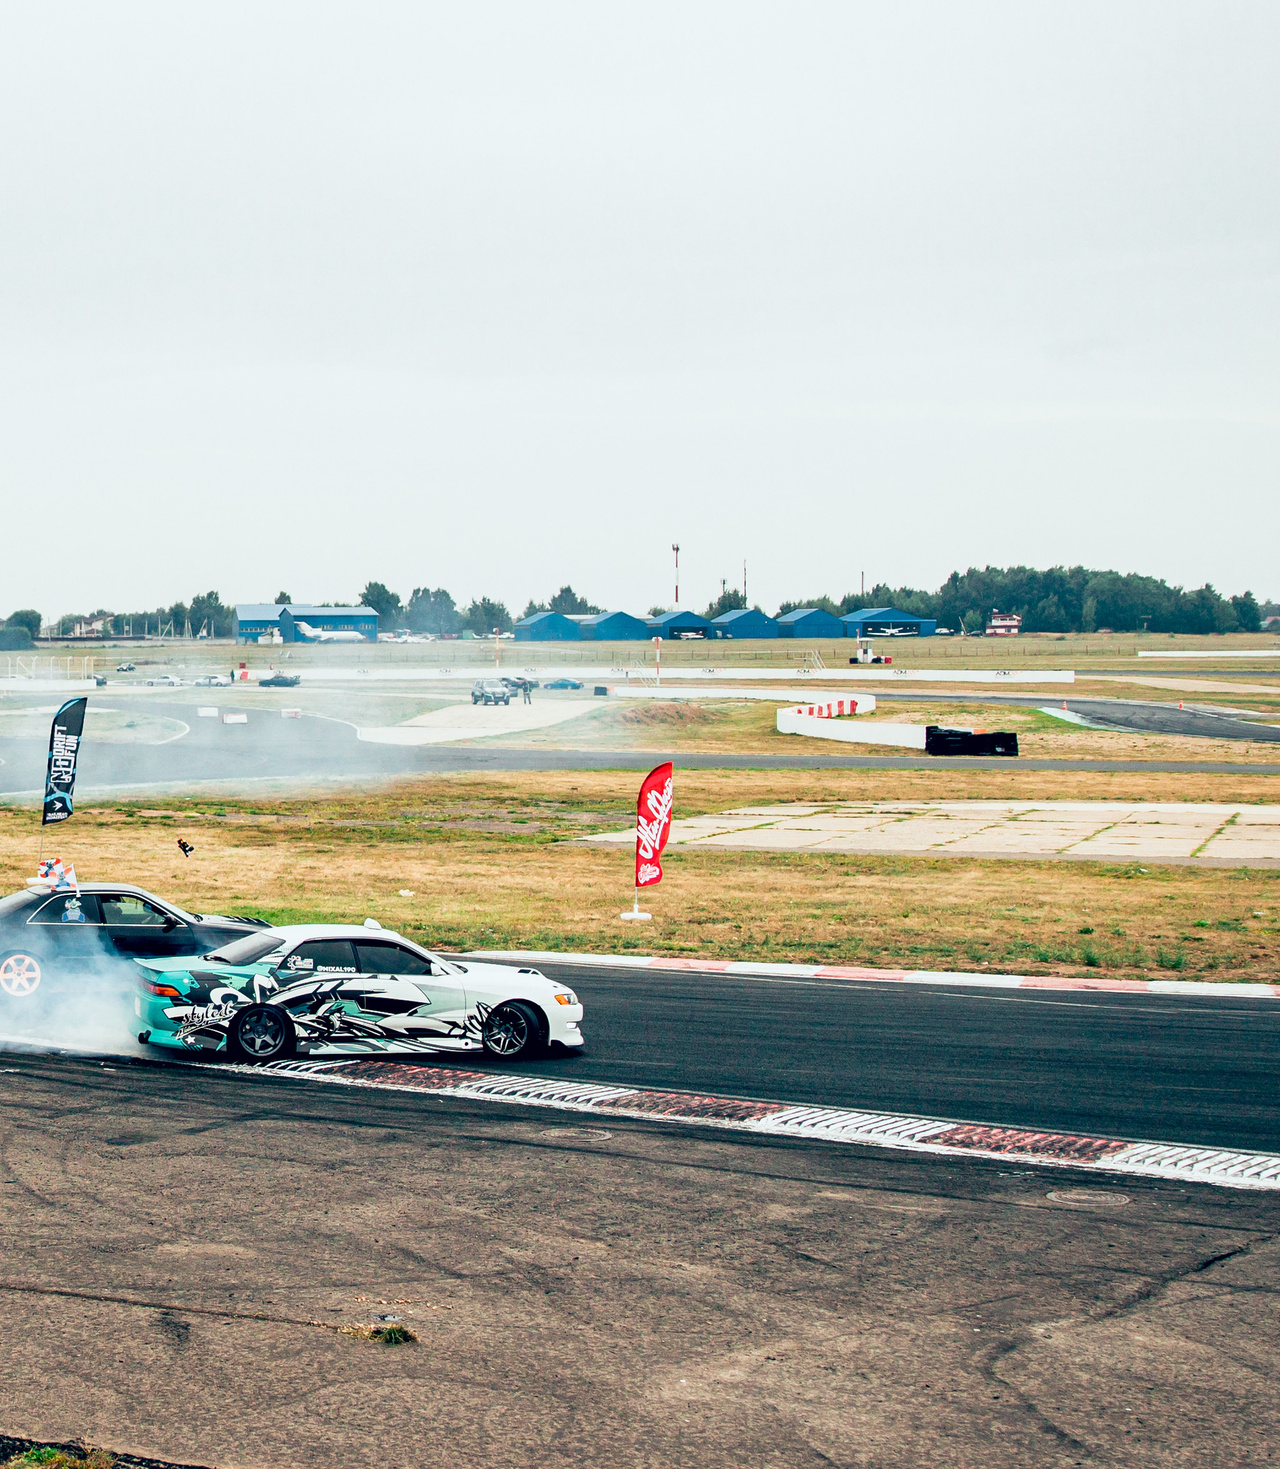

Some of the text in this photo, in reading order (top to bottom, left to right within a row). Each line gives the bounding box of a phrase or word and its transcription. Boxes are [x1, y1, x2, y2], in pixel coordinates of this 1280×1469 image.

[53, 724, 67, 756] DRIFT
[64, 734, 78, 757] FUN
[316, 965, 357, 973] @MIXAL190
